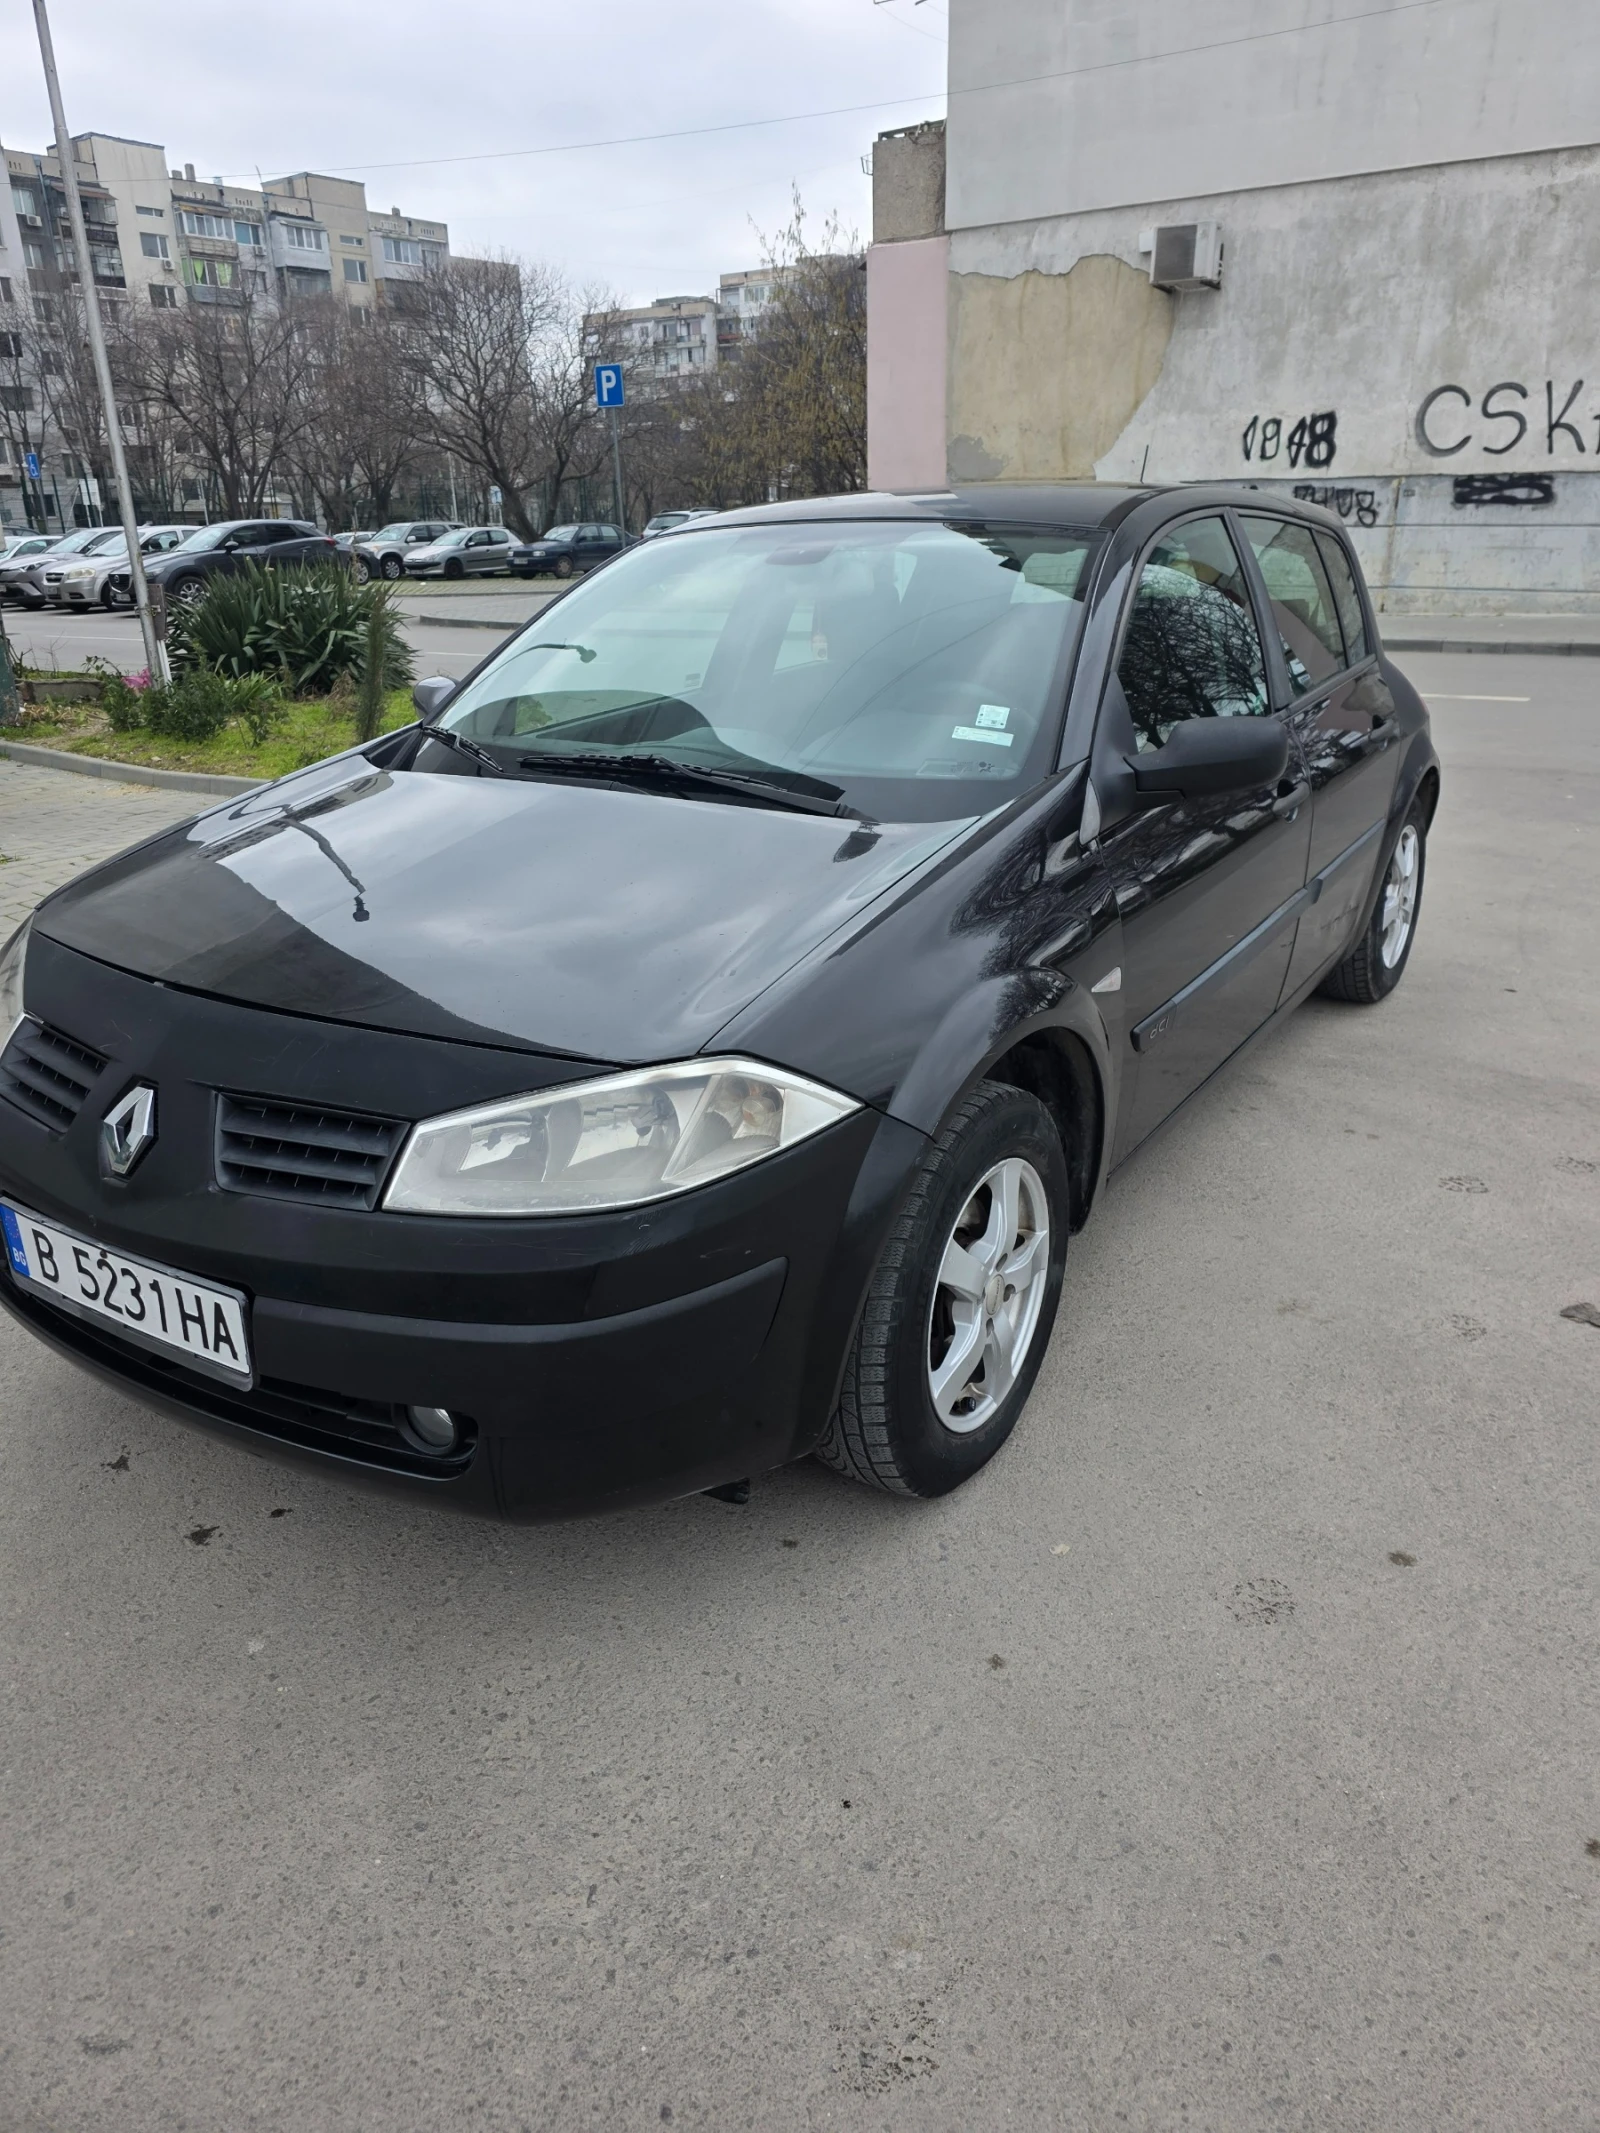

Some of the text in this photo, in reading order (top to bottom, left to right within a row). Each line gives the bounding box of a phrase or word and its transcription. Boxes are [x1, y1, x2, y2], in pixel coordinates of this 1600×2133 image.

[601, 370, 616, 402] P
[12, 1247, 27, 1267] BG
[31, 1228, 60, 1283] B
